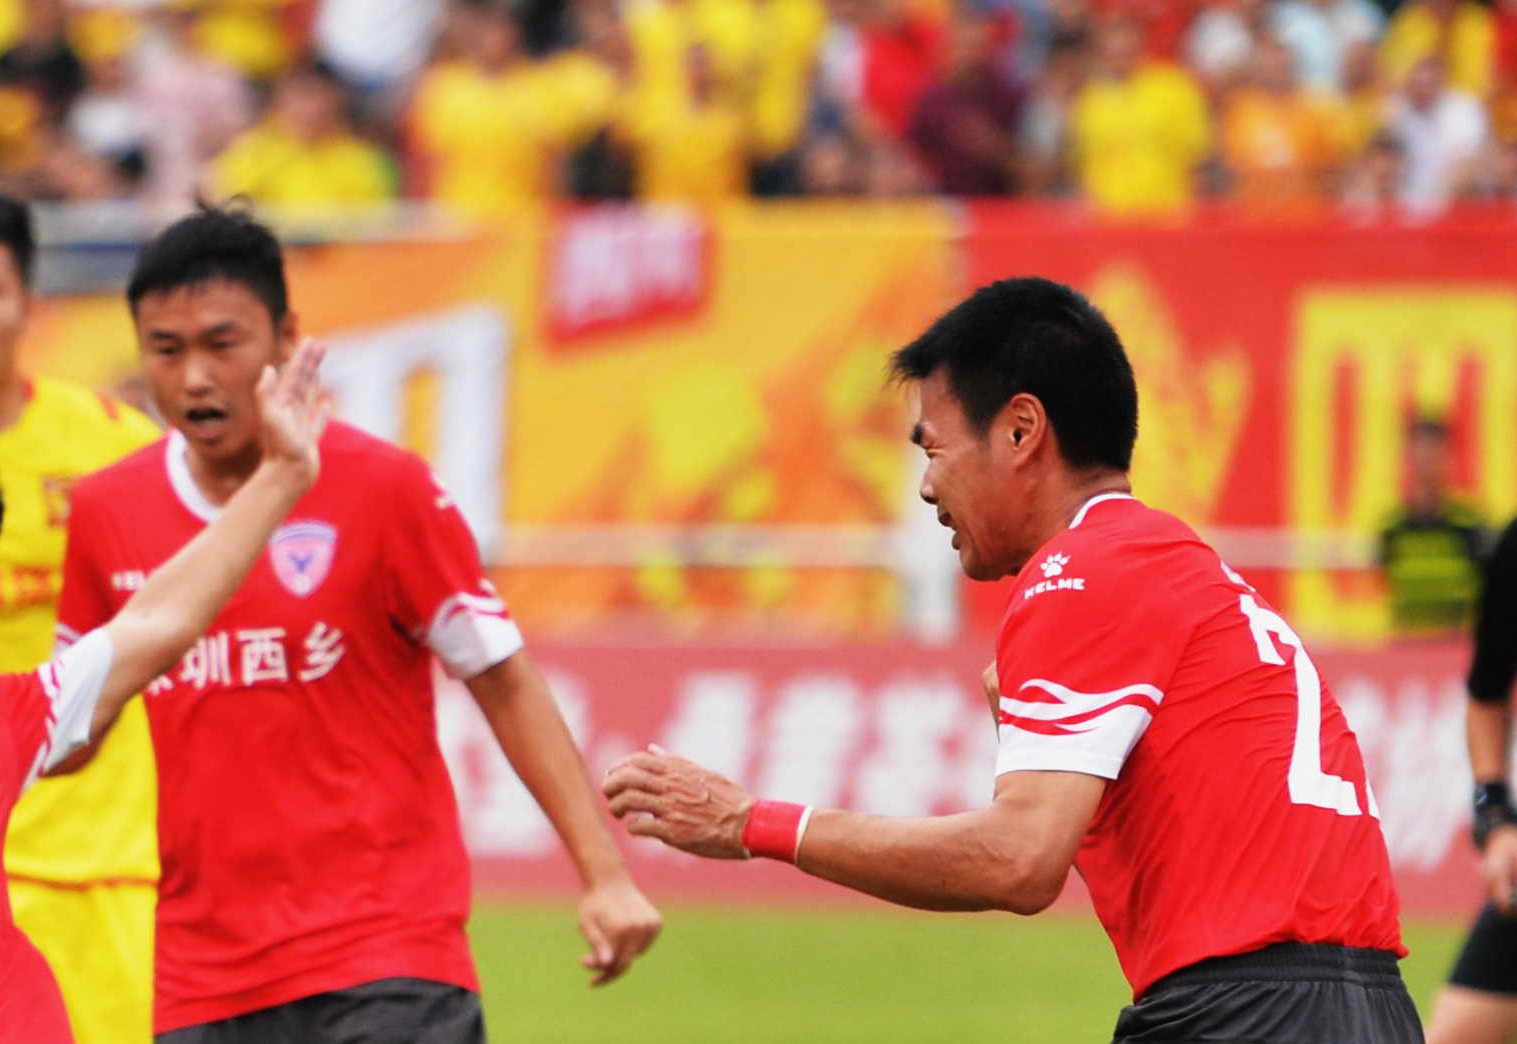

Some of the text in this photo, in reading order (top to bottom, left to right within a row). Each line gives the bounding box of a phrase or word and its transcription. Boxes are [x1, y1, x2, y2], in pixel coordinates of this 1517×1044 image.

[1024, 578, 1085, 600] KELME
[146, 622, 346, 697] 圳西乡
[1238, 594, 1381, 820] 2
